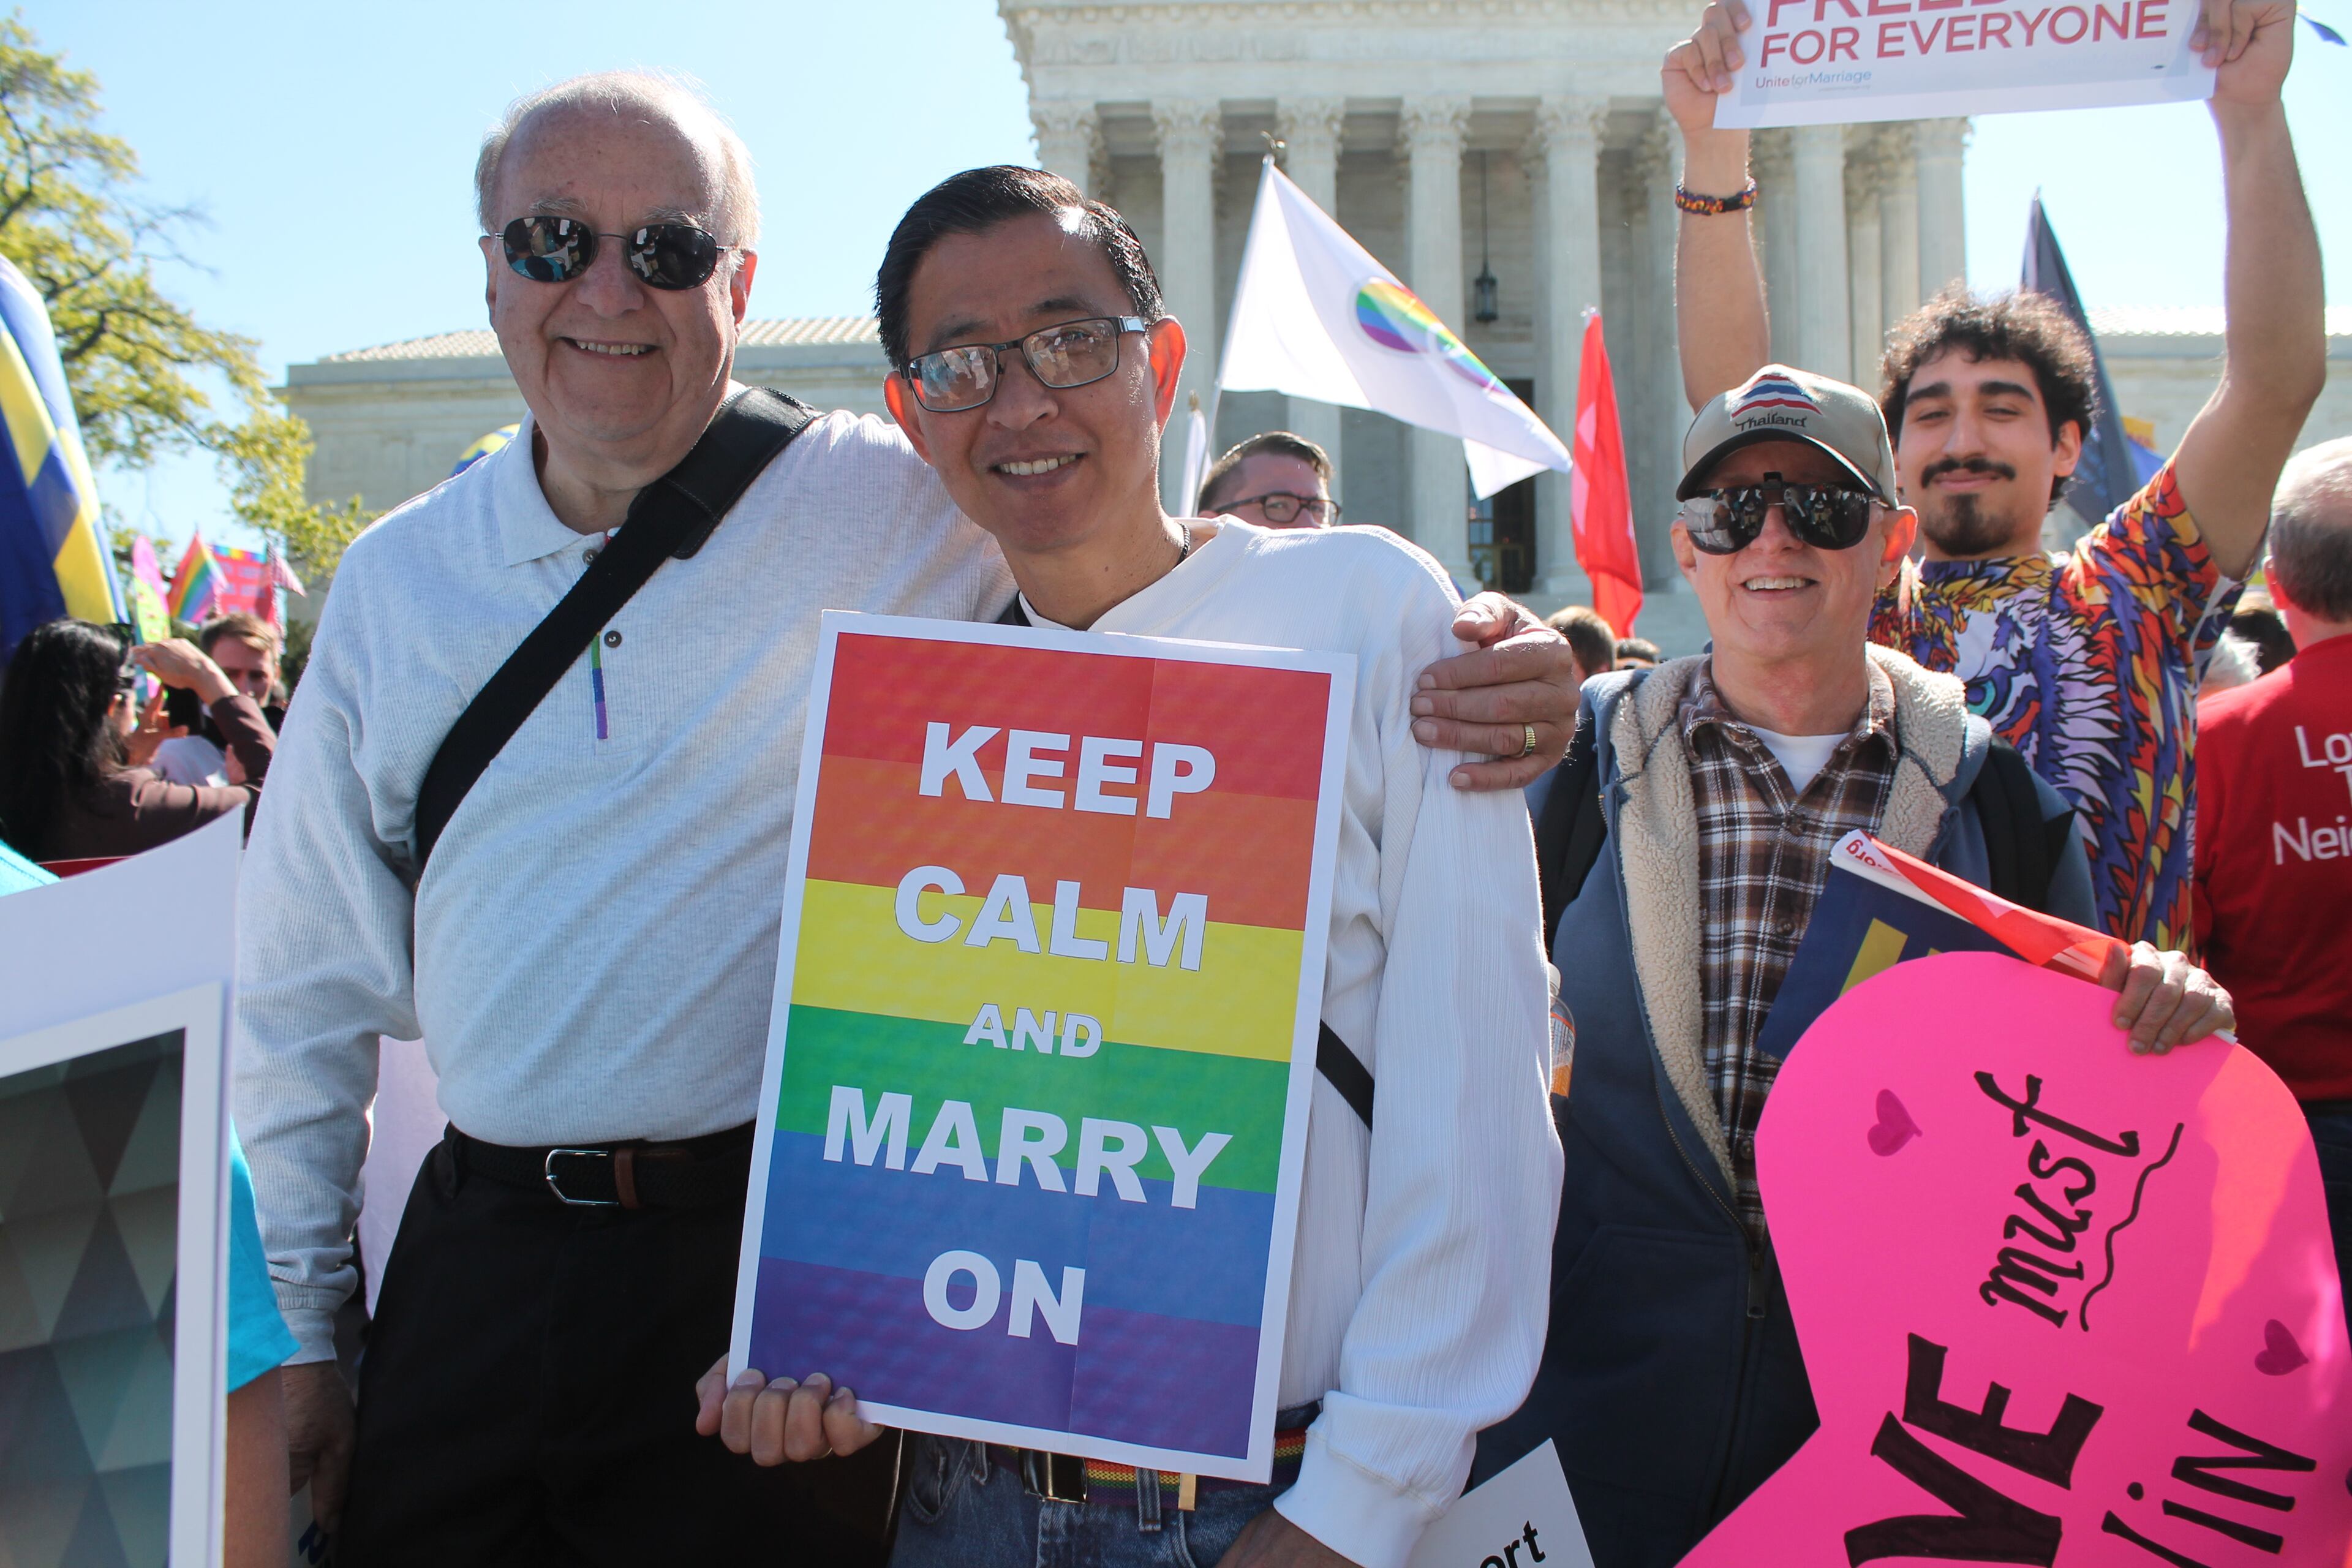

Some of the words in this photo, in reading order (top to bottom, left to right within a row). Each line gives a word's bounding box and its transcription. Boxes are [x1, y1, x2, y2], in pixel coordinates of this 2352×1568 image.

[1761, 27, 1860, 68] FOR
[1877, 0, 2169, 59] EVERYONE
[1735, 412, 1807, 431] Thailand
[919, 722, 1216, 820] KEEP
[2294, 725, 2352, 768] Lo
[2273, 815, 2352, 865] Nei
[895, 865, 1208, 972] CALM
[963, 1004, 1102, 1058] AND
[823, 1085, 1232, 1209] MARRY
[1976, 1072, 2139, 1327] must
[923, 1251, 1085, 1346] ON
